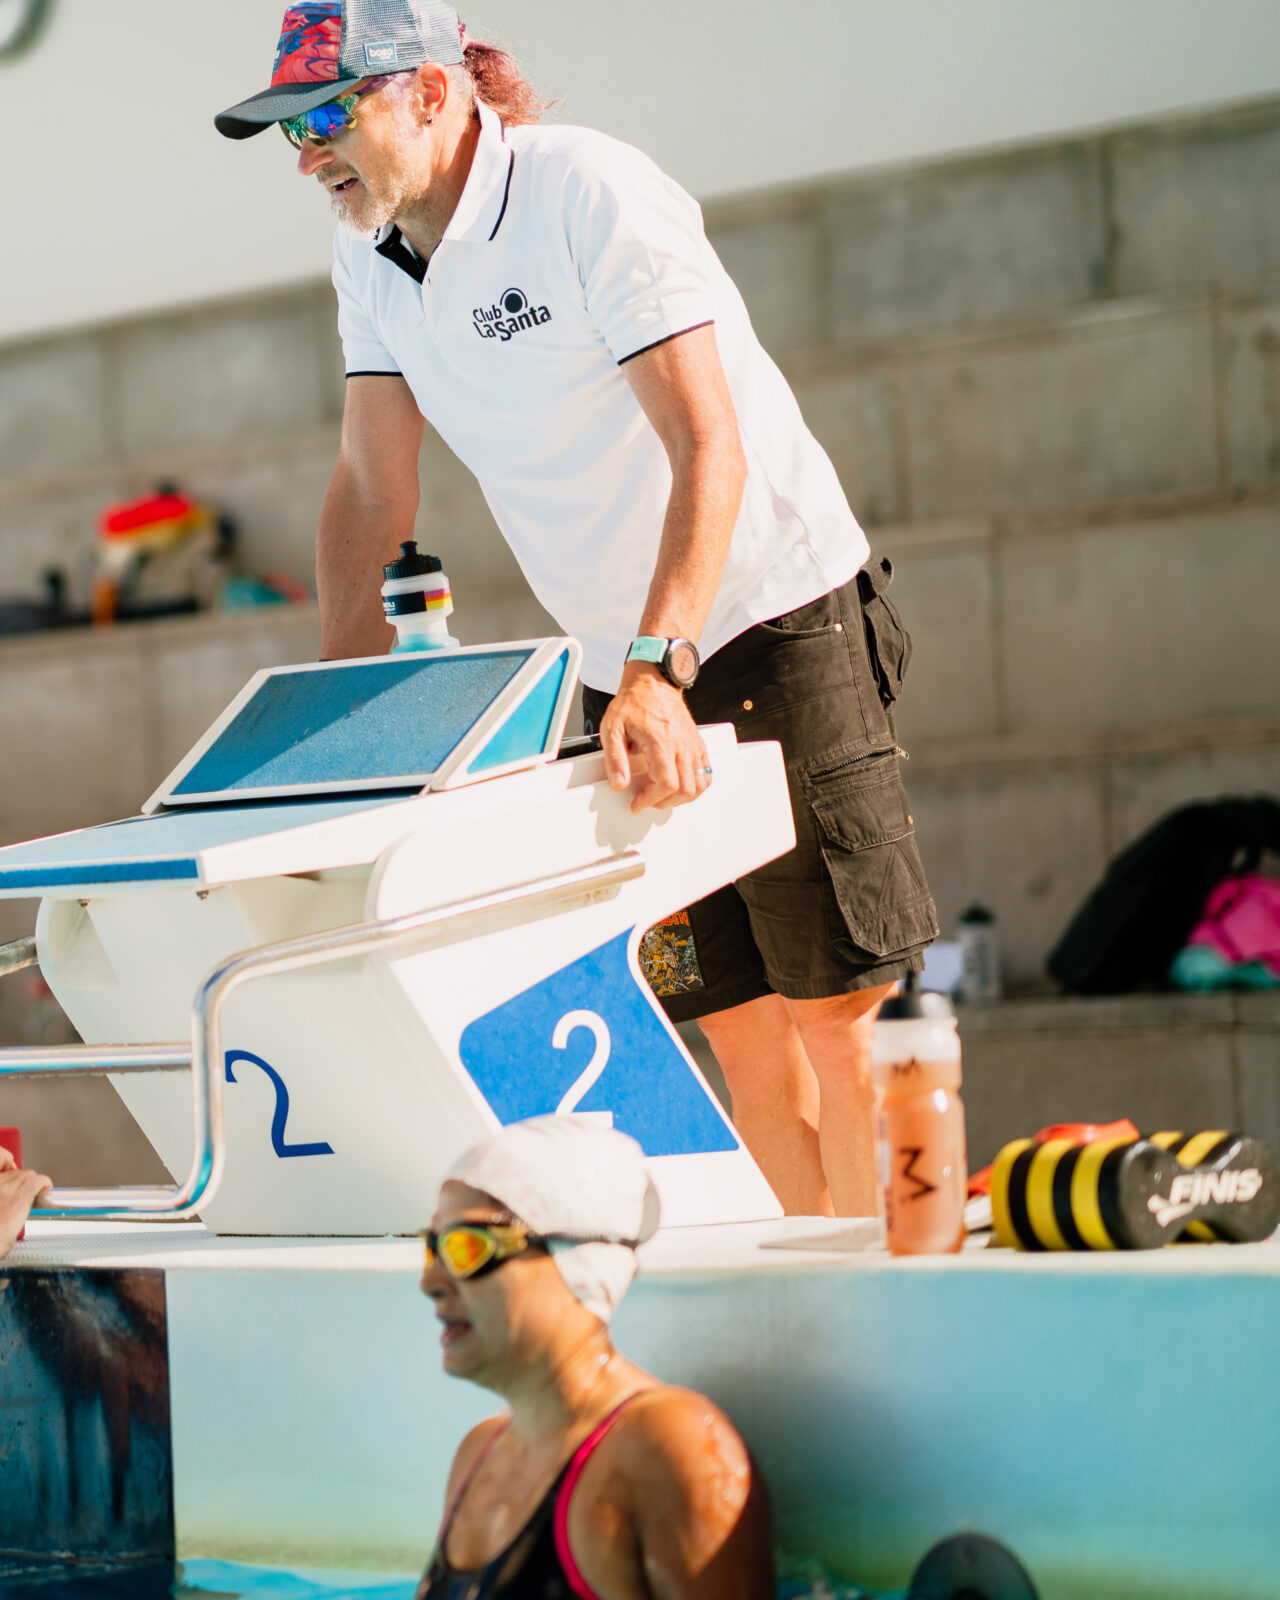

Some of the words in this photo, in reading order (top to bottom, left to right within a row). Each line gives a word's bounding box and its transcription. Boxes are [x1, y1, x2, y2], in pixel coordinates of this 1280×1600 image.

[472, 304, 503, 323] Club
[225, 1049, 336, 1159] 2
[552, 1009, 614, 1129] 2
[1169, 1167, 1263, 1206] FINIS
